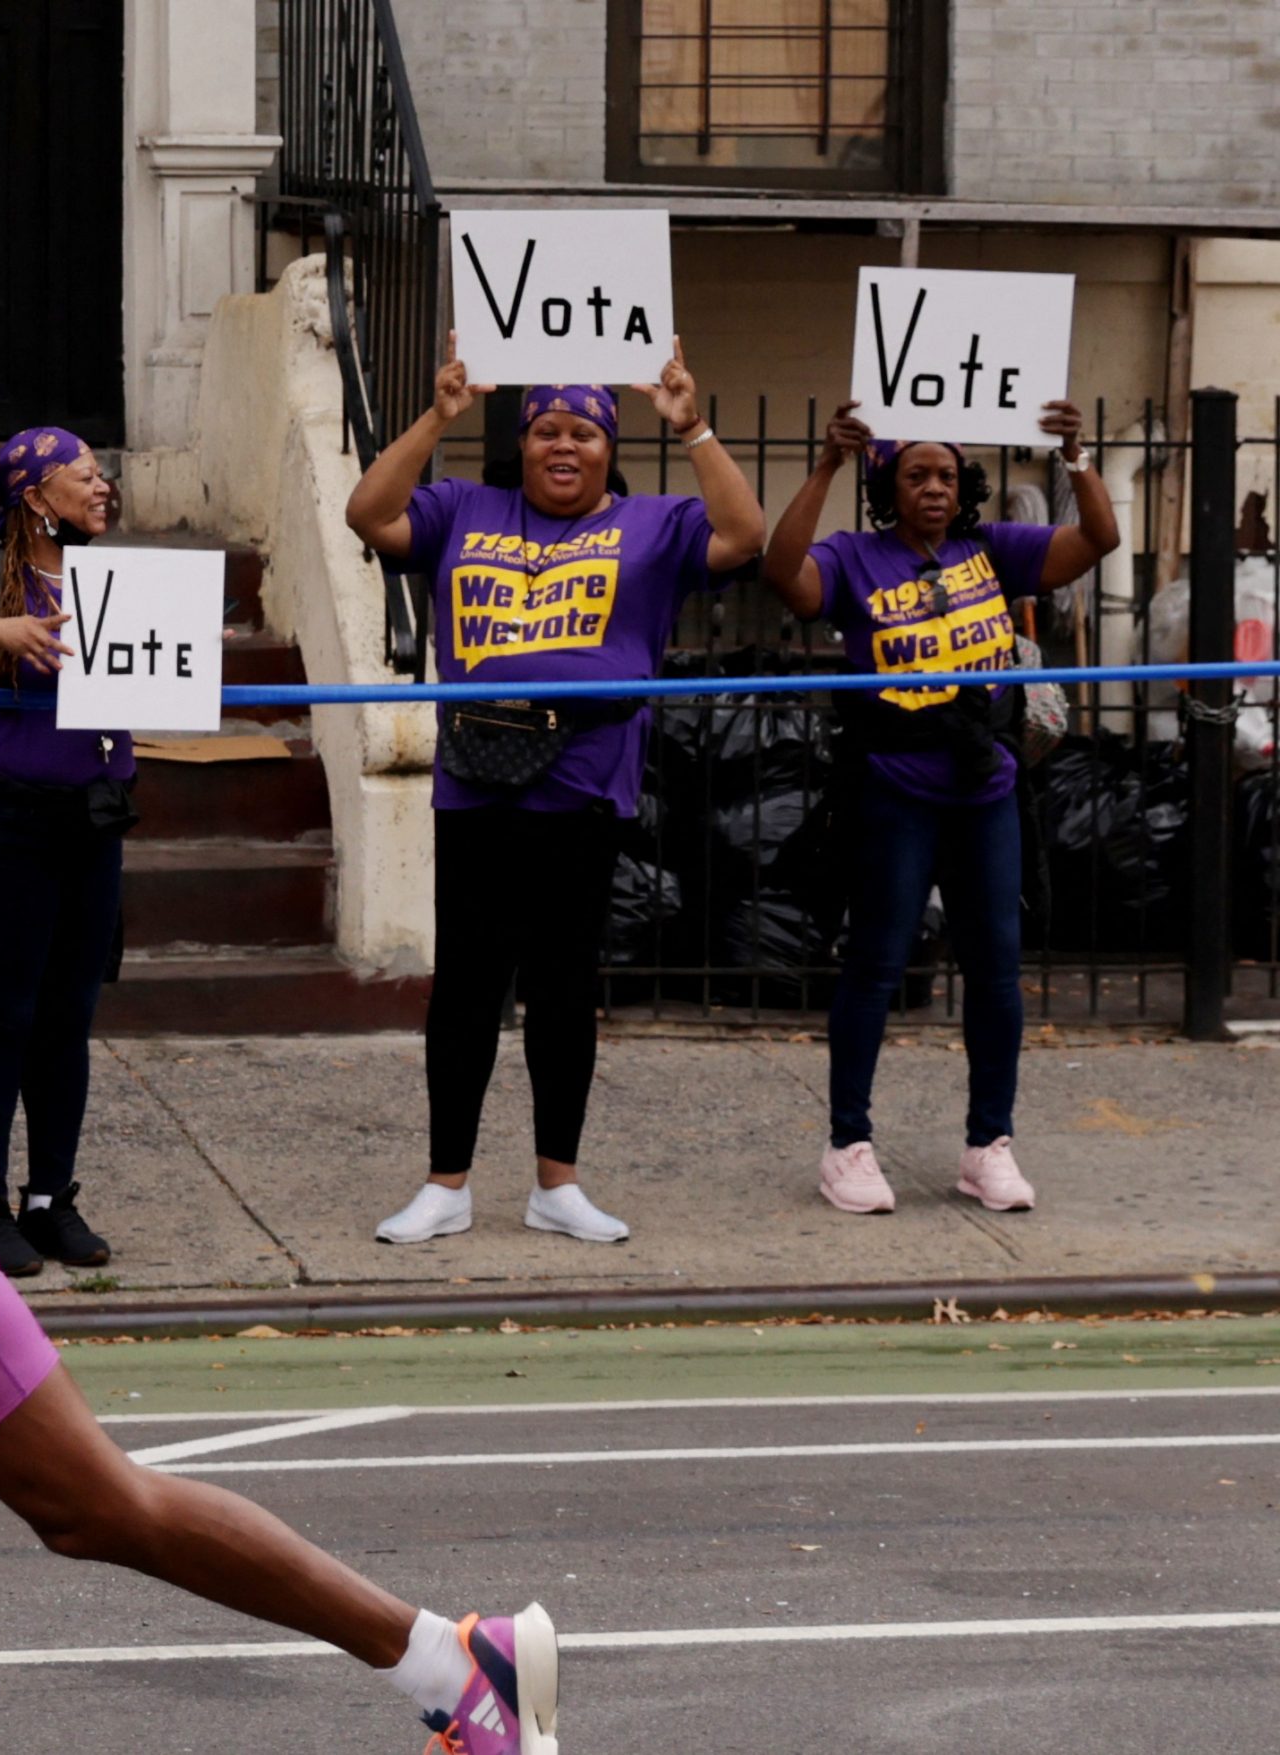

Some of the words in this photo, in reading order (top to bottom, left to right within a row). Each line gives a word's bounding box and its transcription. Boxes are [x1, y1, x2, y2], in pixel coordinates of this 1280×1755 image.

[459, 575, 514, 608] We
[524, 573, 607, 610] care
[459, 615, 512, 648] We
[522, 607, 602, 642] vote
[880, 633, 940, 667] We
[950, 612, 1014, 652] care
